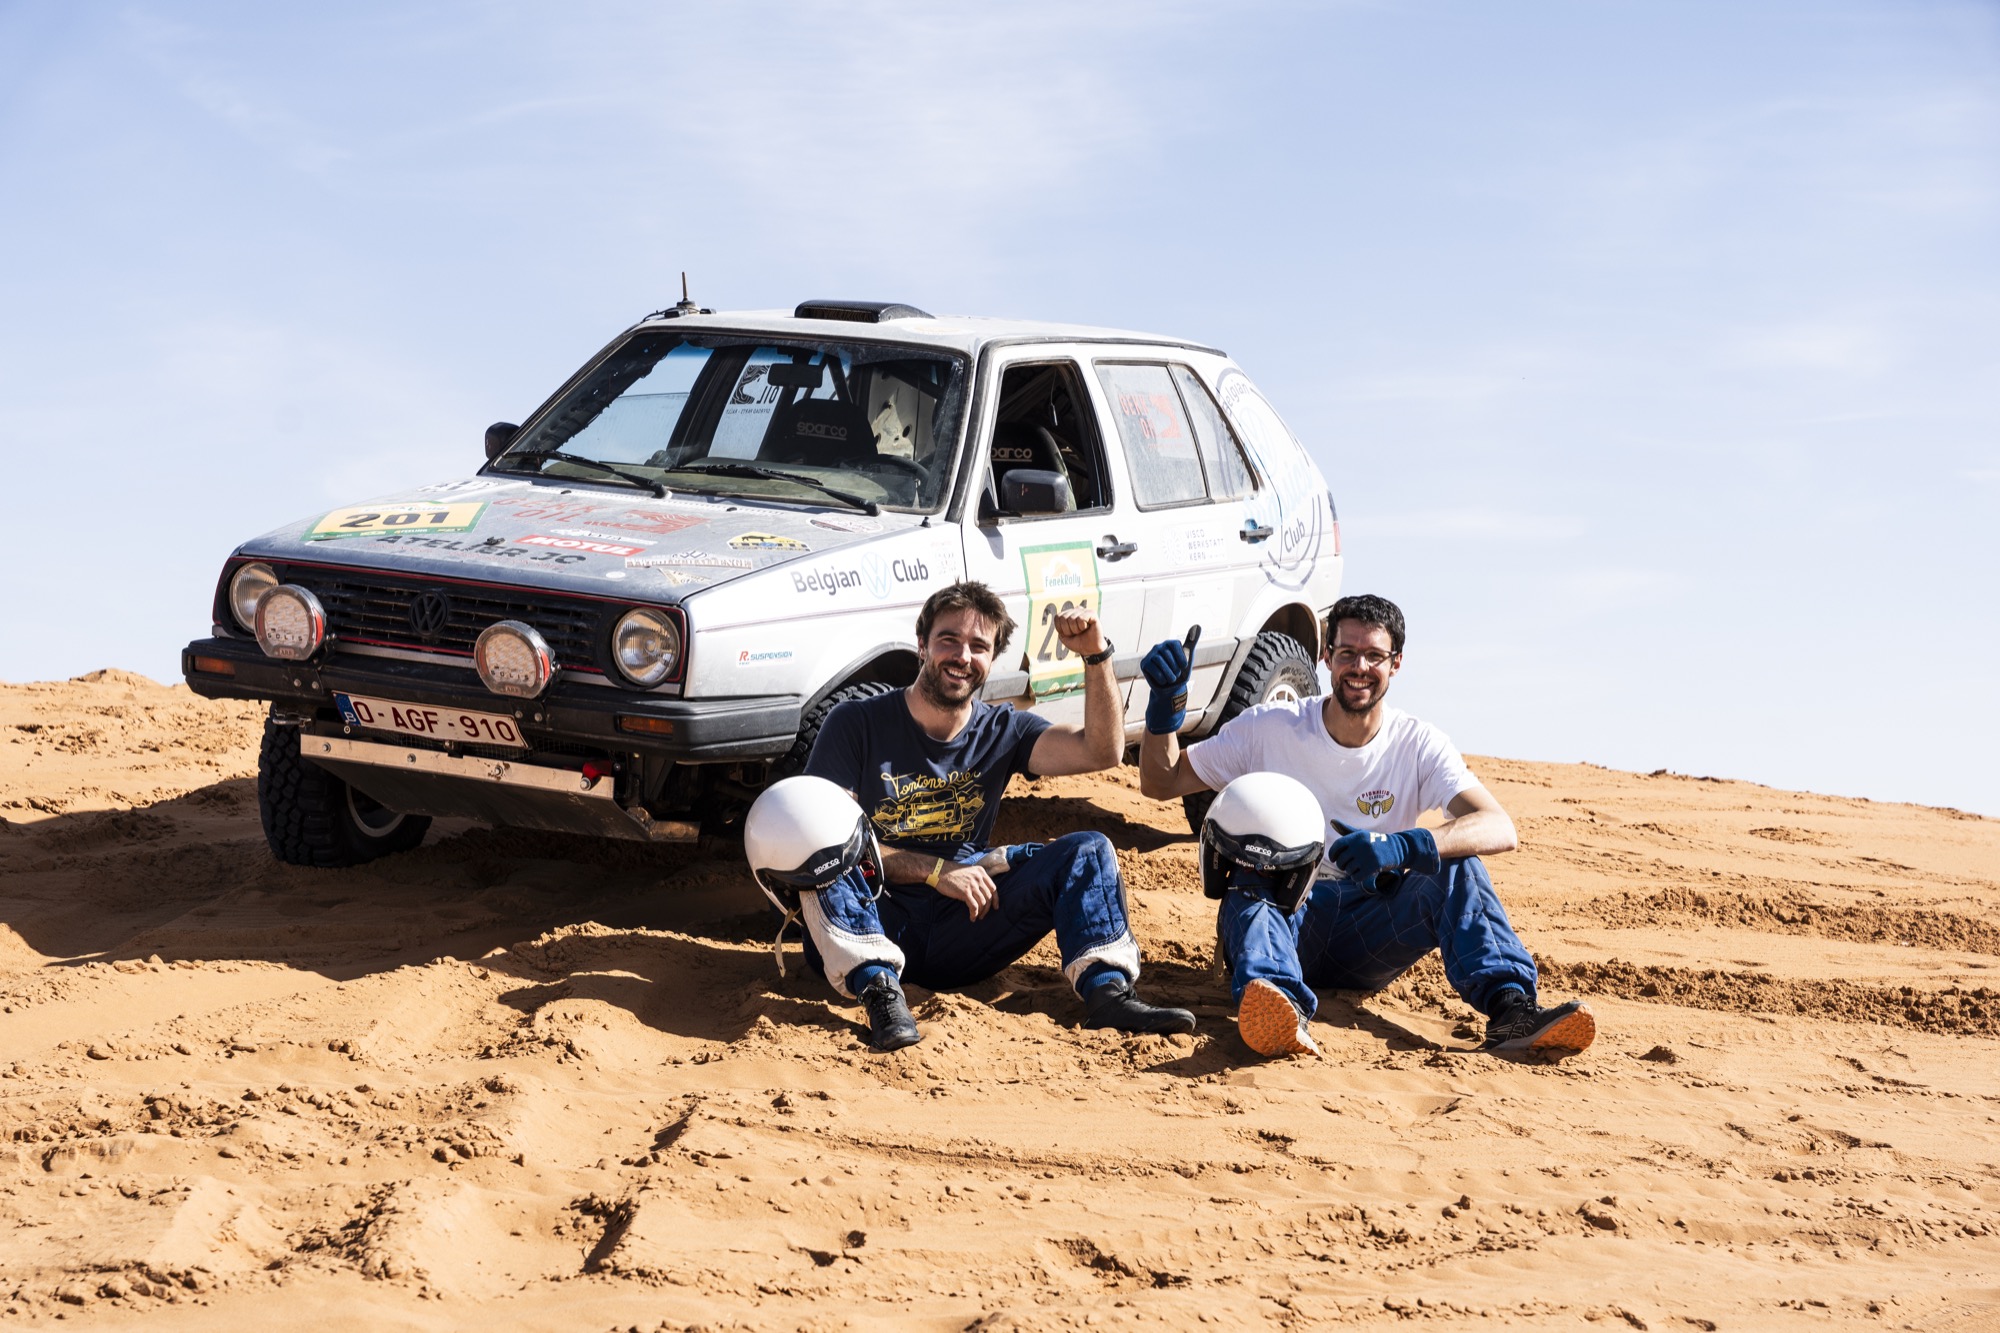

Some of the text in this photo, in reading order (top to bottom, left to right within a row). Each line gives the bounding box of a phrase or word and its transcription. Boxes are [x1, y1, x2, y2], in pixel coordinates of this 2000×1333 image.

[1221, 379, 1249, 418] Belgian
[797, 421, 848, 438] sparco
[339, 511, 450, 528] 201
[513, 509, 582, 523] OIL
[1184, 528, 1206, 539] VISCO
[1283, 517, 1306, 554] Club
[377, 535, 528, 557] ATELIER
[530, 552, 587, 565] JC
[522, 535, 634, 555] MOTUL
[1187, 538, 1224, 551] WERKSTATT
[1188, 551, 1207, 562] KERN
[791, 565, 862, 596] Belgian
[892, 557, 929, 583] Club
[267, 632, 303, 642] SOLIS
[490, 670, 529, 681] SOLIS
[881, 772, 947, 799] Tontons
[1245, 844, 1272, 857] sparco
[814, 858, 841, 876] sparco
[1235, 857, 1255, 868] Belgian
[815, 866, 853, 890] Belgian Club
